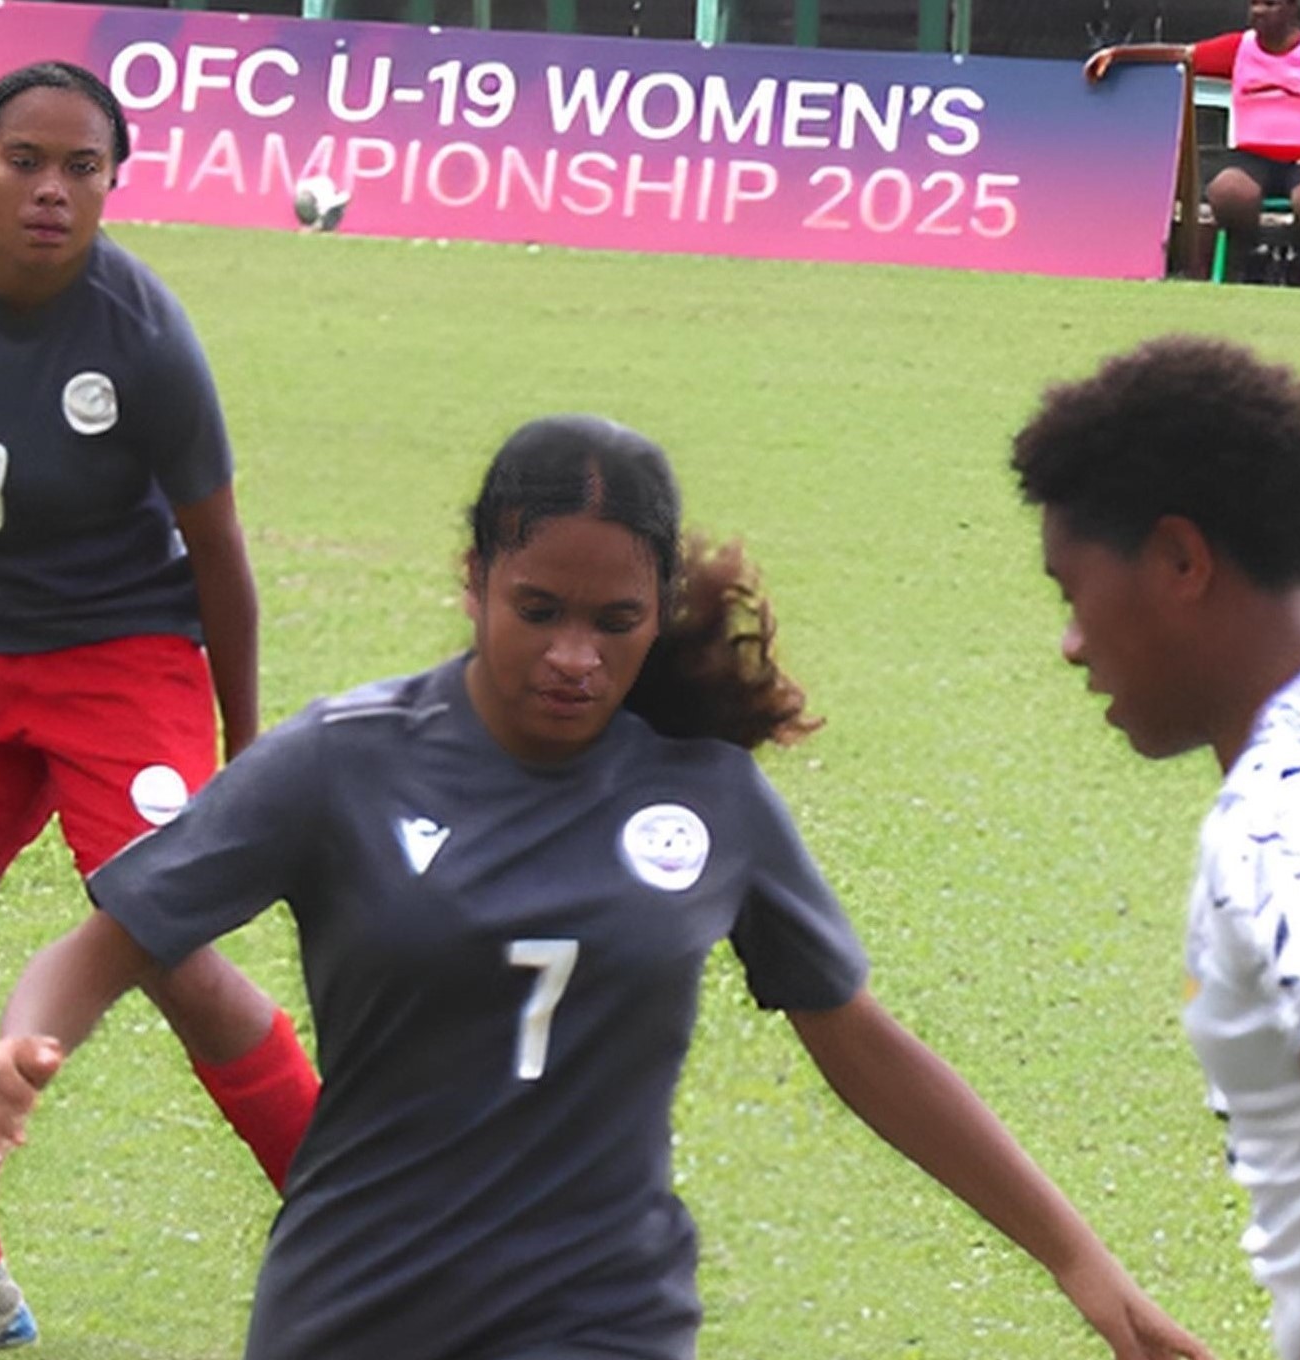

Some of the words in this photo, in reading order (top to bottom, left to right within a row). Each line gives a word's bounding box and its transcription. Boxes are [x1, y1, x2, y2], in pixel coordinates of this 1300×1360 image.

[109, 41, 300, 118] OFC
[327, 52, 516, 126] U-19
[547, 65, 986, 156] WOMEN'S
[116, 123, 779, 224] HAMPIONSHIP
[802, 166, 1020, 239] 2025
[507, 939, 579, 1079] 7
